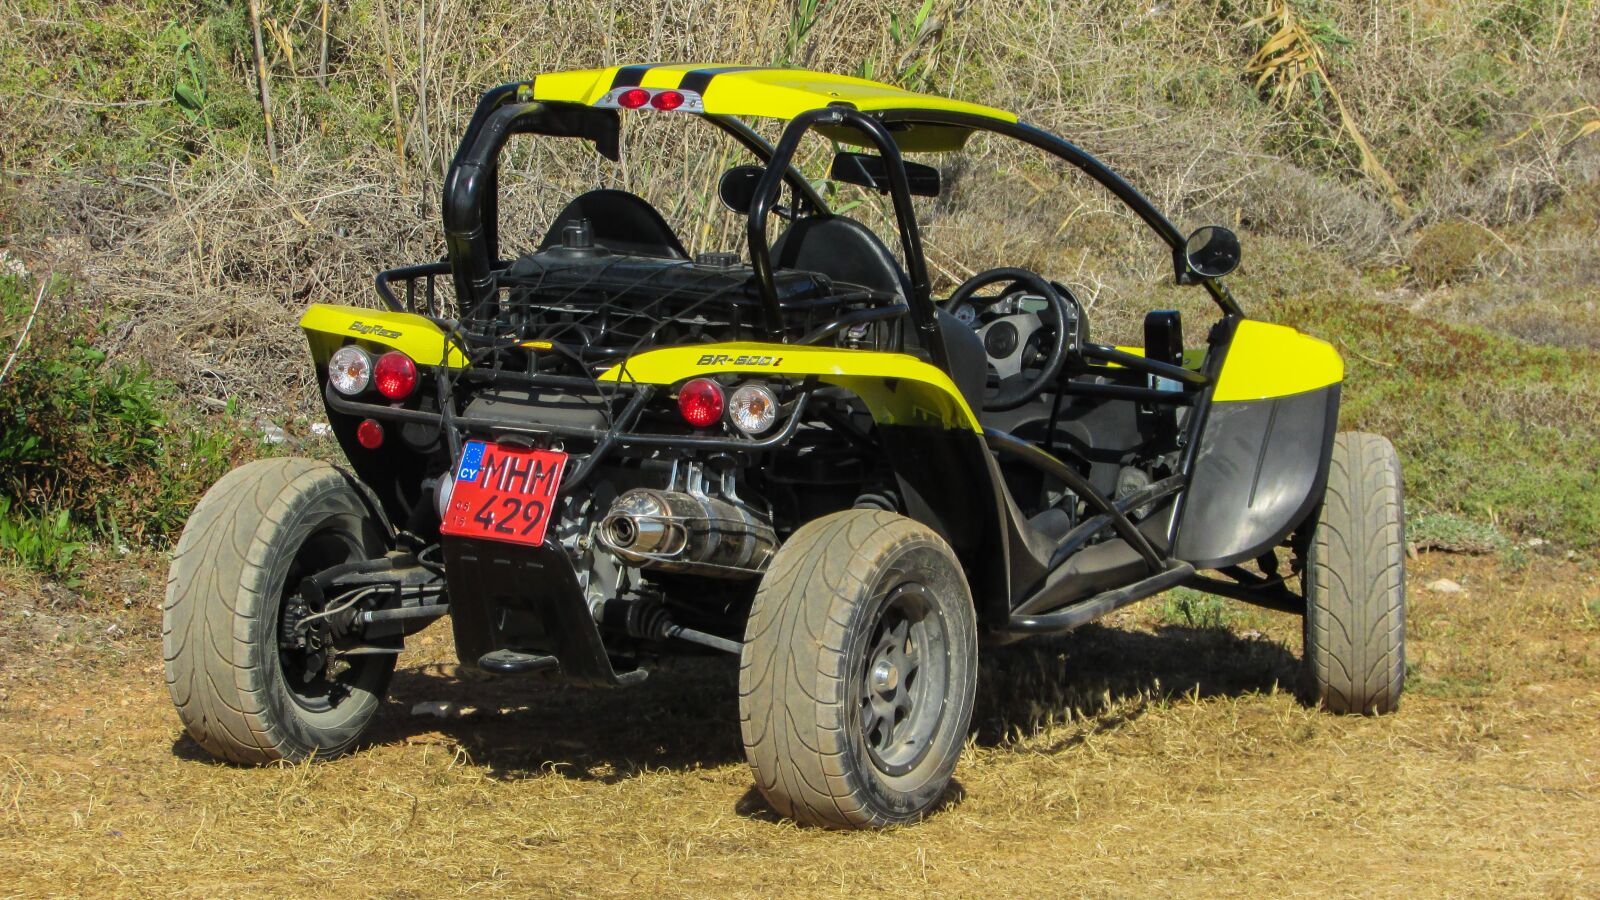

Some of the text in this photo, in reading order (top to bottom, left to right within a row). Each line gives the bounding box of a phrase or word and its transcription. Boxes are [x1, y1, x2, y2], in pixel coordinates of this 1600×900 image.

[460, 468, 478, 479] CY
[480, 453, 559, 497] MHM
[474, 495, 545, 536] 429
